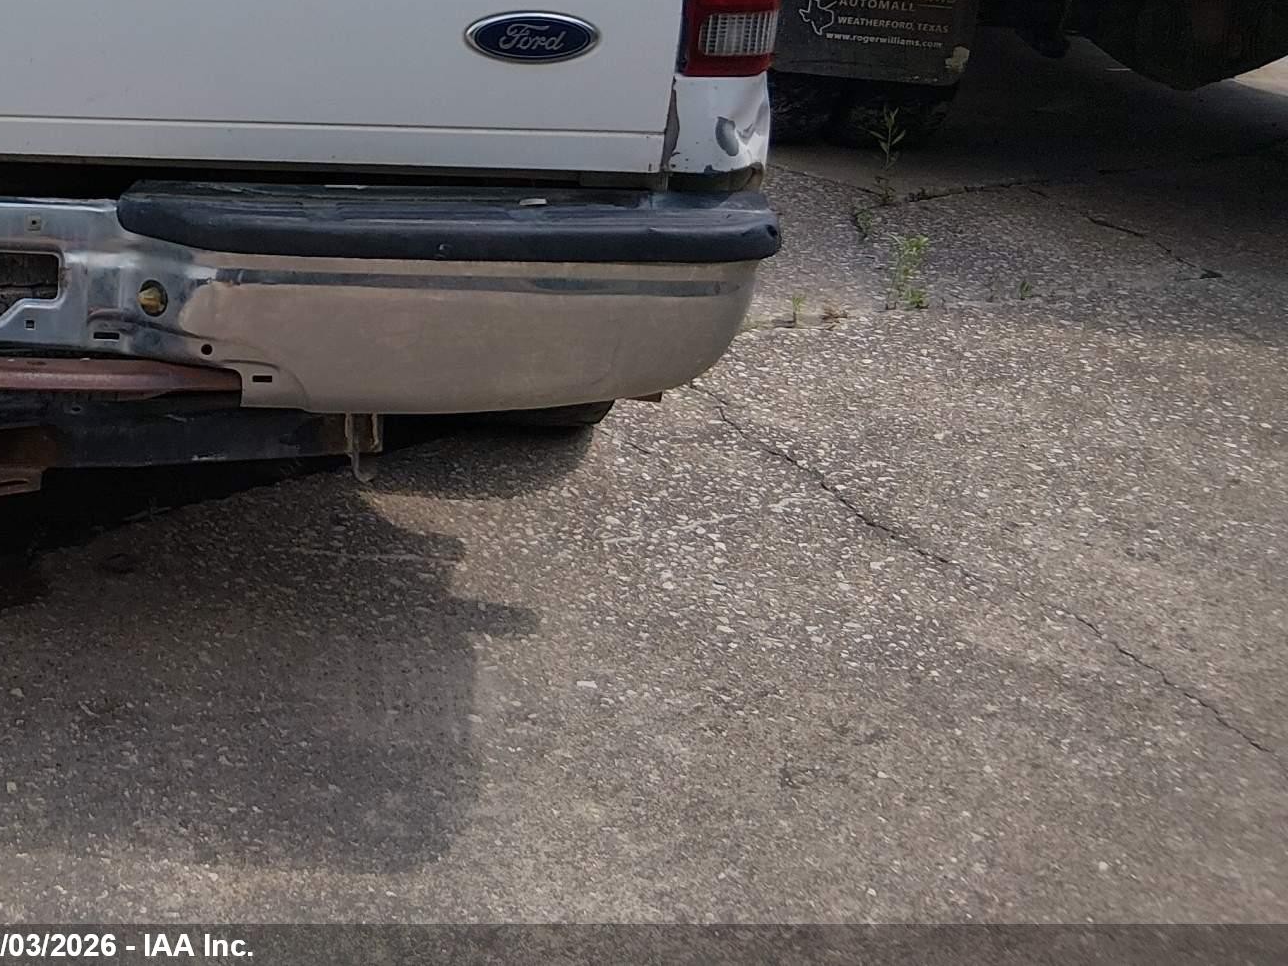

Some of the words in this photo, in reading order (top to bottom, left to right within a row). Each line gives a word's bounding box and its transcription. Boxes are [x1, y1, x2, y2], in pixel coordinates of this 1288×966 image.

[498, 23, 567, 50] Ford
[917, 23, 950, 34] TEXAS
[826, 31, 944, 49] www.rogerwilliams.com
